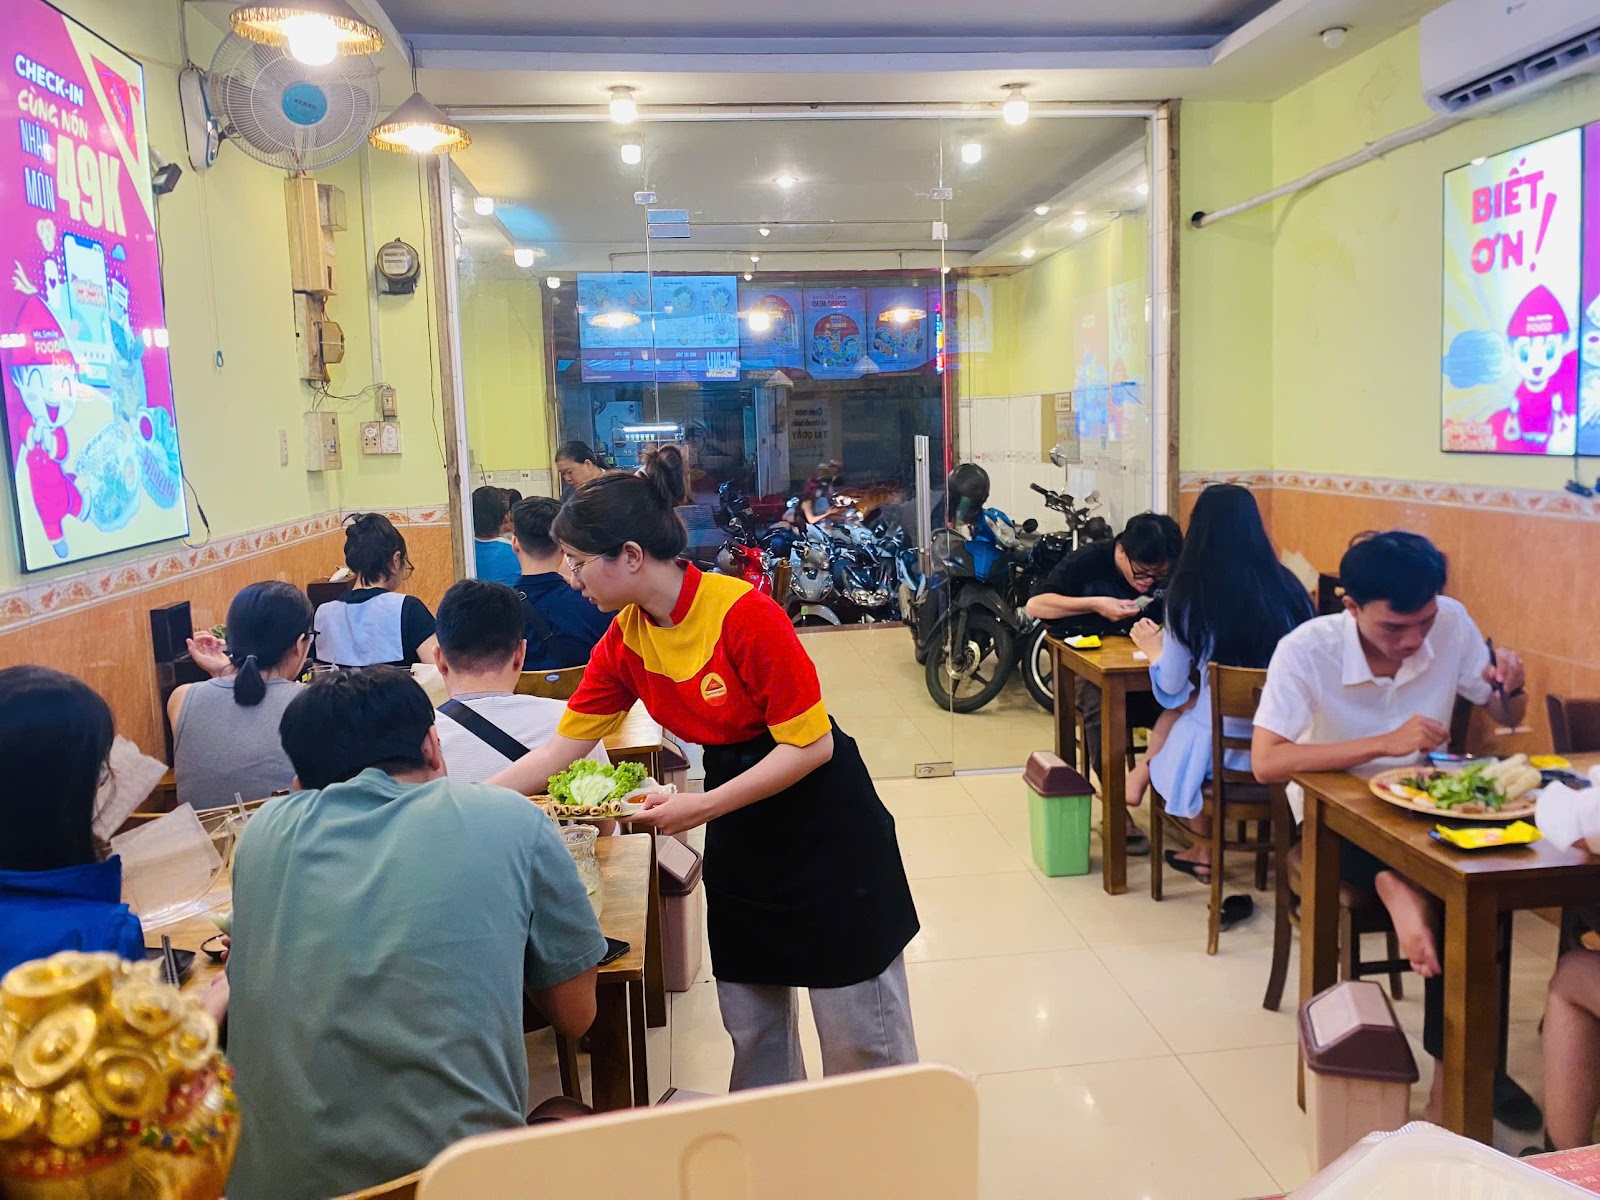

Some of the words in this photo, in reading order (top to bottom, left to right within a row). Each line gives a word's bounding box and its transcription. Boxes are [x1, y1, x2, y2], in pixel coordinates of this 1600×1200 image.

[15, 54, 83, 107] CHECK-IN
[18, 86, 58, 129] CÙNG
[61, 109, 87, 141] NÓN
[25, 167, 55, 212] MÓN
[57, 134, 126, 237] 49K
[1472, 157, 1544, 225] BIẾT
[35, 341, 60, 354] FOOD
